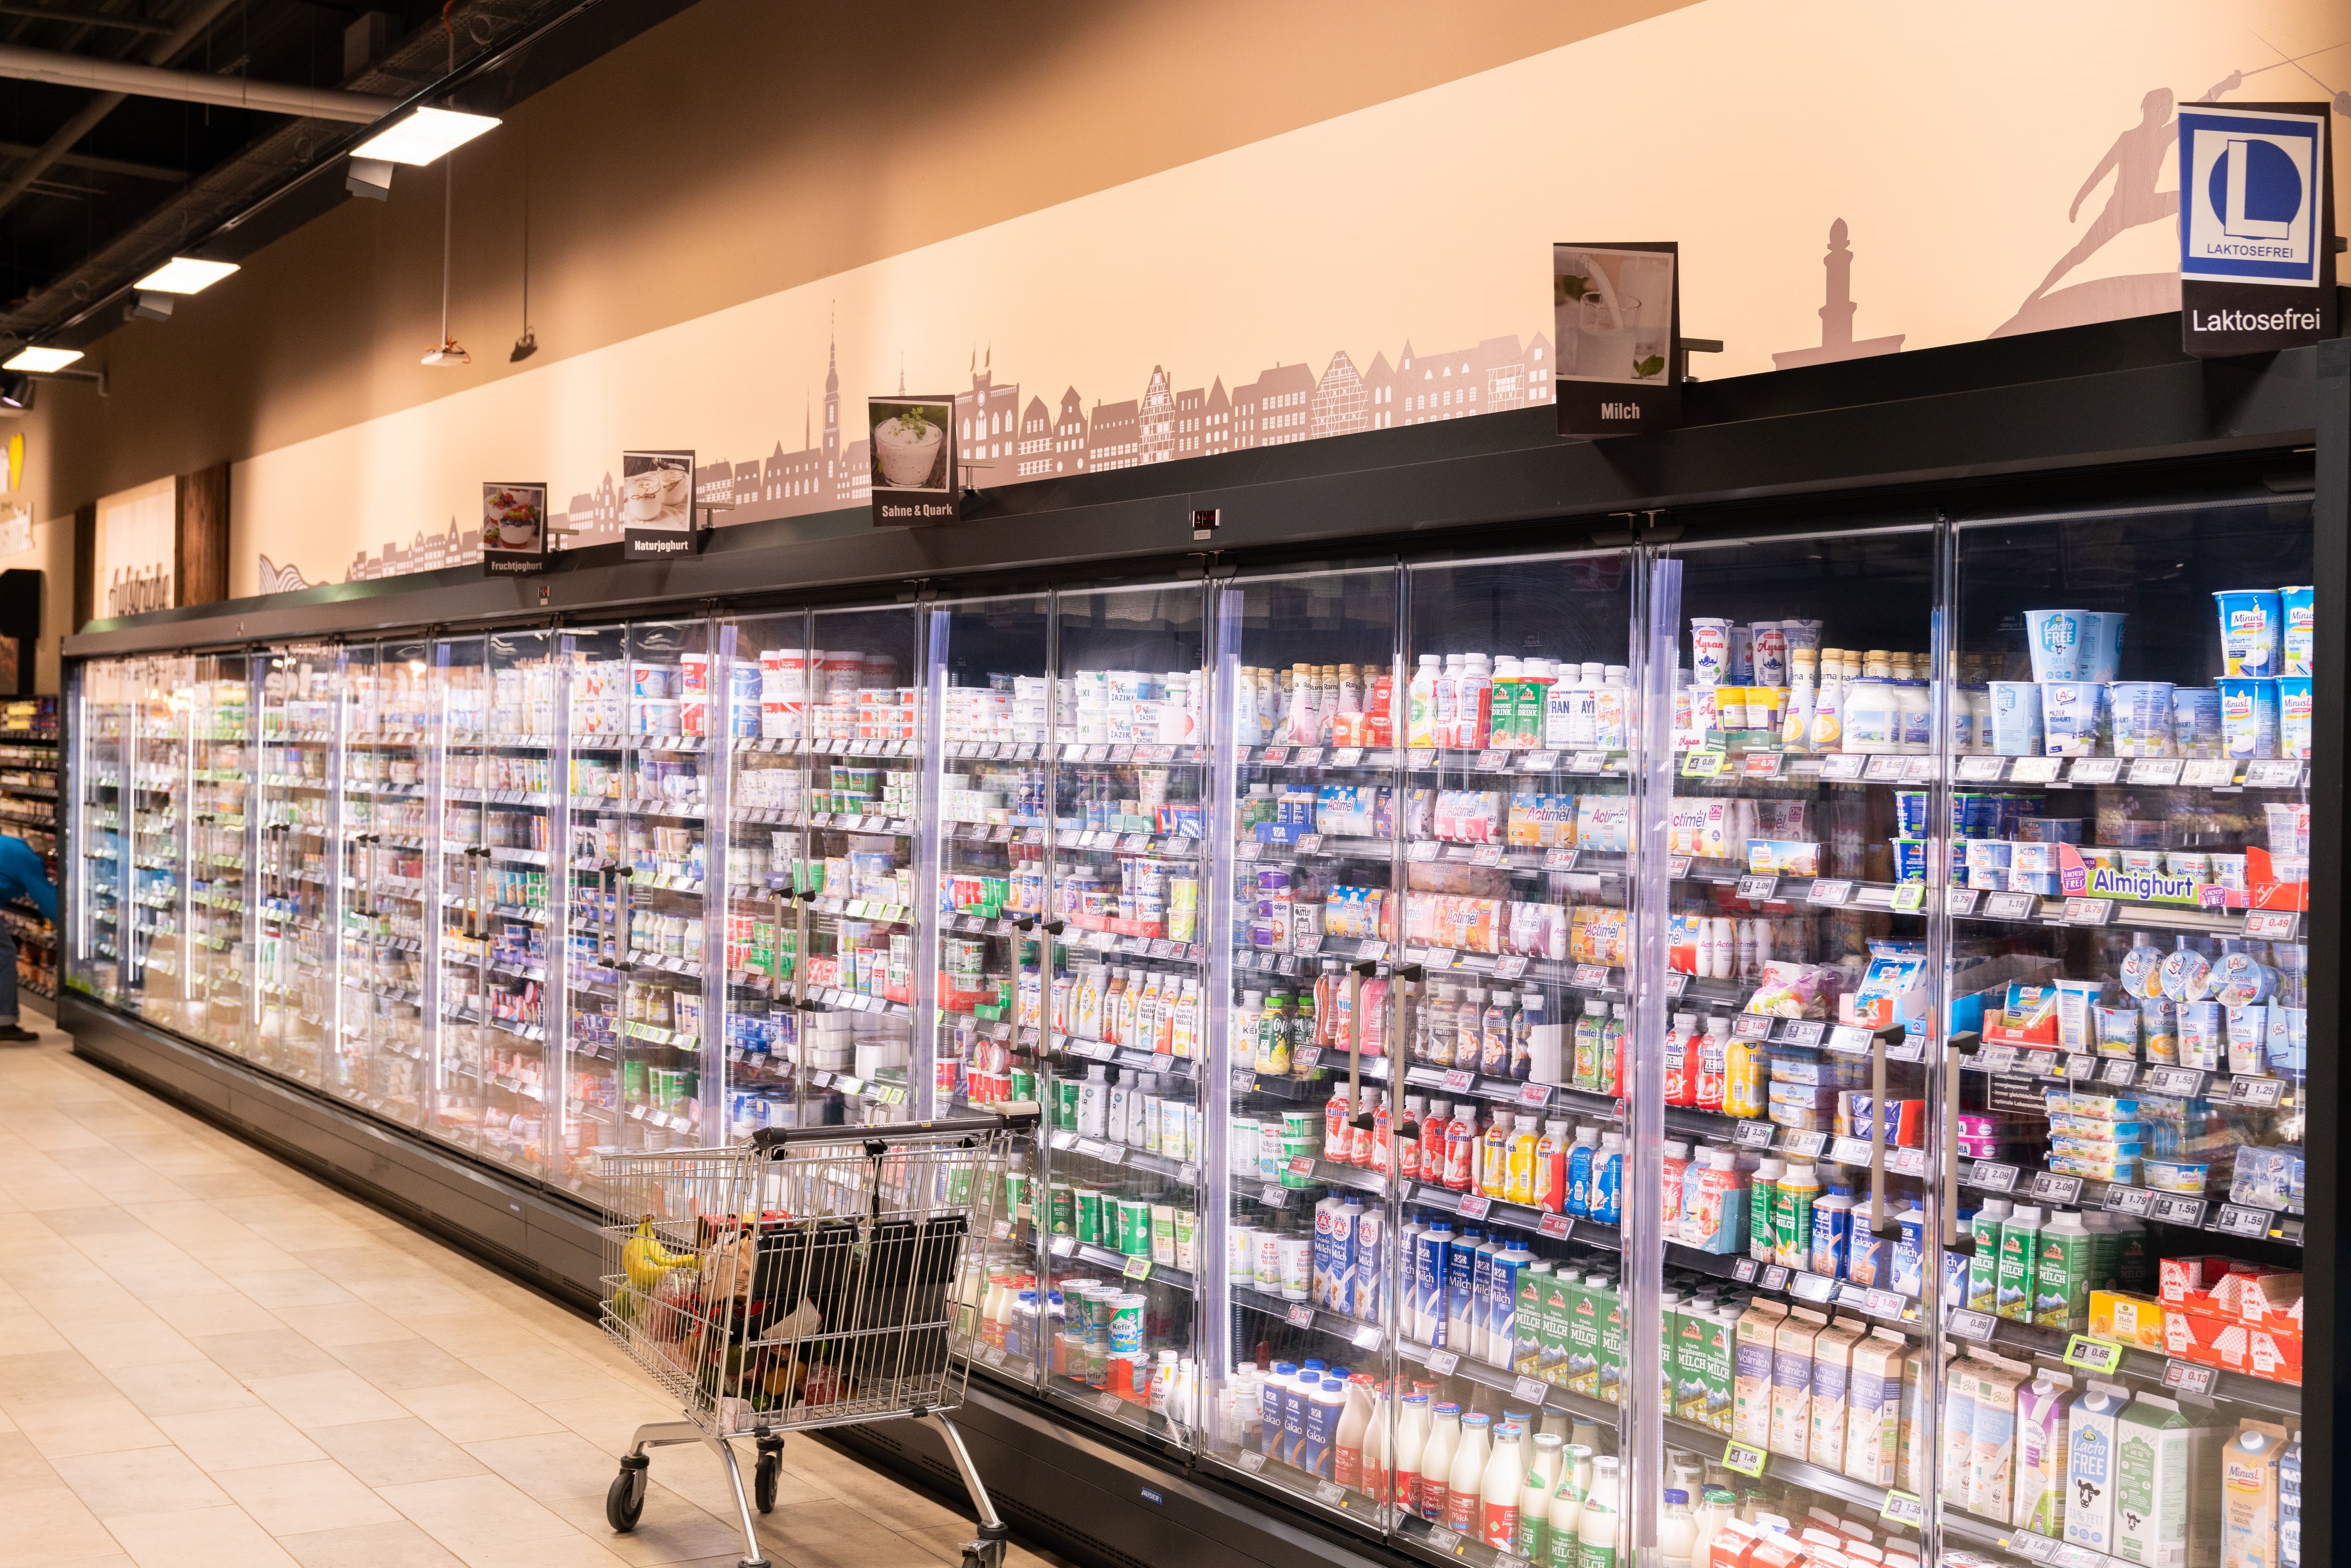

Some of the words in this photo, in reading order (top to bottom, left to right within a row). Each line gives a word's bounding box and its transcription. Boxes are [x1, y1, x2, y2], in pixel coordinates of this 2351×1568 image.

[2207, 243, 2294, 260] LAKTOSEFREI
[2193, 307, 2321, 332] Laktosefrei
[1601, 402, 1641, 420] Milch
[882, 506, 912, 517] Sahne
[915, 505, 920, 516] &
[923, 504, 953, 517] Quark
[634, 540, 689, 553] Naturjoghurt
[491, 561, 542, 572] Fruchtjoghurt
[2234, 612, 2264, 622] MinusL
[2044, 622, 2074, 632] Lacto
[2045, 631, 2073, 645] FREE
[1695, 637, 1723, 654] Ayran
[1678, 735, 1700, 749] Ayran
[1326, 798, 1354, 812] Actimel
[1525, 806, 1570, 822] Actimel
[1756, 882, 1769, 890] 2.09
[2066, 879, 2084, 888] FREI
[2094, 869, 2193, 899] Almighurt
[2085, 905, 2102, 914] 0.79
[2269, 918, 2288, 927] 0.49
[2134, 957, 2154, 986] KOCHSAHNE
[2171, 960, 2200, 990] SCHLAGSAHNE
[2218, 975, 2252, 984] SCHLAGSAHNE
[2009, 1005, 2039, 1014] Toastscheiben
[1666, 1056, 1683, 1067] ZERO
[1704, 1059, 1724, 1072] ZERO
[2175, 1075, 2193, 1084] 1.55
[1995, 1082, 2029, 1090] energiesparend
[2256, 1086, 2274, 1095] 1.25
[2010, 1092, 2044, 1101] gleichbleibende
[1752, 1127, 1766, 1137] 3.39
[1803, 1136, 1818, 1146] 2.99
[1852, 1145, 1868, 1155] 1.59
[1991, 1170, 2010, 1181] 2.09
[2054, 1182, 2073, 1192] 2.09
[2128, 1195, 2147, 1206] 1.79
[2177, 1204, 2197, 1215] 1.59
[1554, 1221, 1567, 1230] 0.69
[2243, 1214, 2263, 1226] 1.59
[1315, 1242, 1331, 1254] Milch
[1851, 1237, 1873, 1248] Kakao
[1358, 1255, 1373, 1267] Milch
[2039, 1265, 2067, 1275] Bergbauern
[1449, 1276, 1472, 1290] Milch
[2039, 1271, 2066, 1284] MILCH
[1882, 1300, 1898, 1308] 1.09
[1516, 1307, 1541, 1317] Bergbauern
[1516, 1314, 1541, 1329] MILCH
[1543, 1313, 1568, 1325] Bergbauern
[1970, 1319, 1988, 1329] 0.89
[2119, 1315, 2132, 1324] Hefe
[1542, 1321, 1568, 1337] MILCH
[1570, 1321, 1598, 1334] Bergbauern
[1570, 1330, 1597, 1345] MILCH
[1677, 1347, 1706, 1359] Bergbauern
[1743, 1347, 1765, 1358] Frische
[1678, 1353, 1706, 1369] MILCH
[1737, 1352, 1770, 1369] Vollmilch
[1782, 1356, 1803, 1369] Frische
[1707, 1363, 1730, 1380] MILCH
[1776, 1362, 1808, 1379] Vollmilch
[1820, 1366, 1839, 1378] Frische
[1815, 1371, 1844, 1388] Vollmilch
[1857, 1377, 1877, 1388] Frische
[2188, 1371, 2208, 1384] 0.13
[1529, 1386, 1541, 1395] 1.49
[1853, 1382, 1881, 1399] Vollmilch
[1992, 1392, 2010, 1403] Bio
[1978, 1413, 2004, 1426] Fettarme
[1981, 1423, 1999, 1434] Milch
[2073, 1437, 2106, 1455] Lacto
[2073, 1452, 2105, 1476] FREE
[2229, 1466, 2260, 1480] MinusL
[2233, 1501, 2252, 1511] Frische
[2231, 1508, 2255, 1519] fettarme
[2234, 1516, 2249, 1525] Milch
